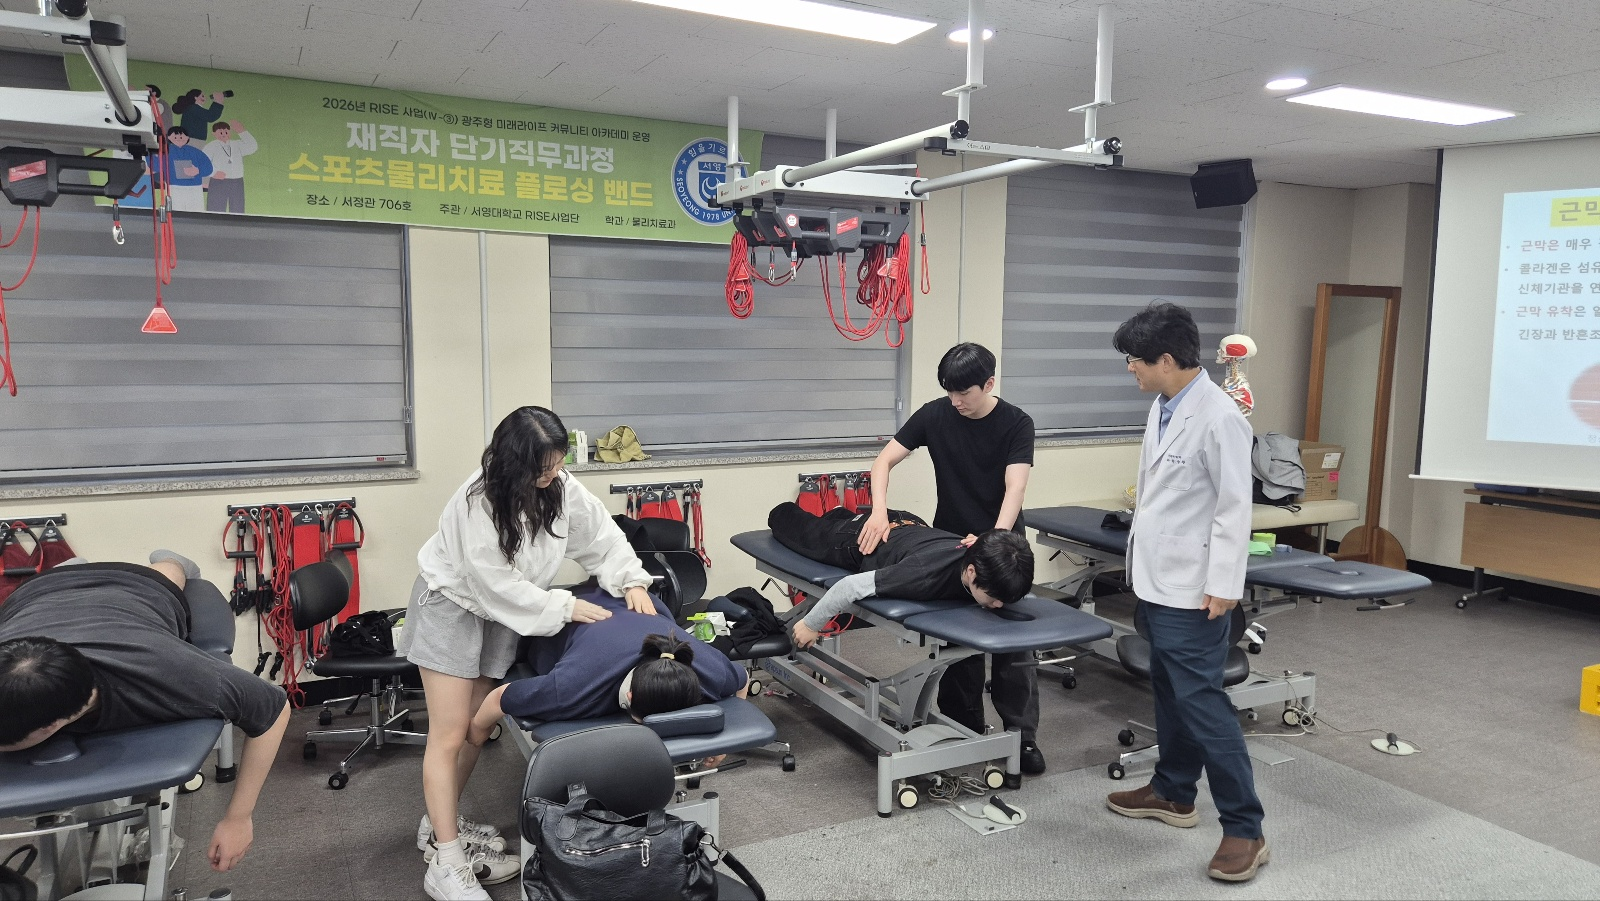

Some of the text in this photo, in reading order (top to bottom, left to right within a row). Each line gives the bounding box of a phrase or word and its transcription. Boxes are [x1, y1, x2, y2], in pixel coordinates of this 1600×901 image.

[322, 97, 366, 113] 2026년
[369, 103, 399, 115] RISE
[461, 115, 493, 129] 광주형
[496, 119, 547, 132] 미래라이프
[550, 123, 588, 137] 커뮤니티
[591, 127, 629, 140] 아카데미
[632, 131, 650, 143] 운영
[346, 122, 614, 174] 재직자 단기직무과정
[702, 162, 727, 172] 서영
[288, 152, 654, 207] 스포츠물리치료 플로싱 밴드
[306, 194, 330, 206] 장소
[341, 196, 376, 209] 서정관
[379, 198, 412, 211] 706호
[676, 177, 700, 216] SEOYEONG
[439, 203, 460, 215] 주관
[471, 206, 522, 220] 서영대학교
[525, 211, 580, 224] RISE사업단
[702, 211, 720, 220] 1978
[605, 215, 624, 226] 학과
[632, 216, 676, 229] 물리치료과
[1520, 239, 1560, 252] 근막은
[1565, 238, 1592, 251] 매우
[1519, 262, 1572, 275] 콜라겐은
[1518, 282, 1584, 295] 신체기관을
[1516, 305, 1541, 318] 근막
[1546, 305, 1587, 318] 유착은
[1518, 328, 1558, 341] 긴장과
